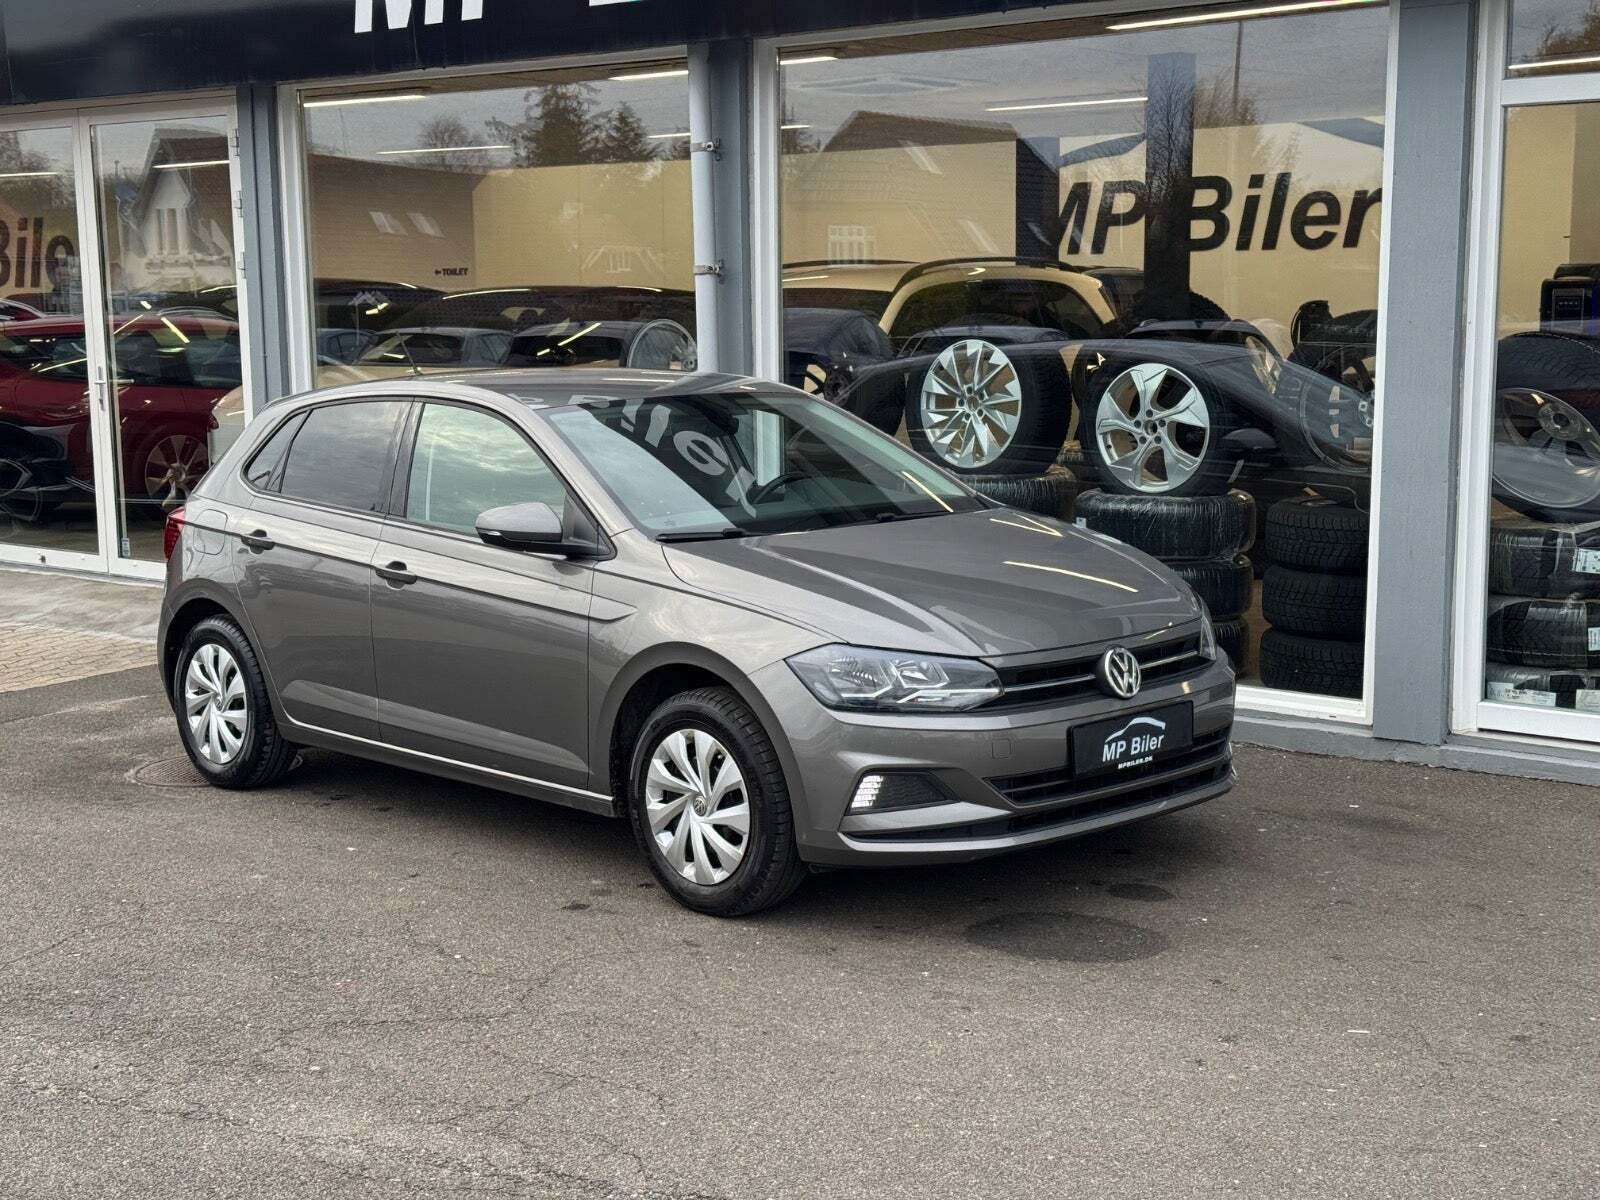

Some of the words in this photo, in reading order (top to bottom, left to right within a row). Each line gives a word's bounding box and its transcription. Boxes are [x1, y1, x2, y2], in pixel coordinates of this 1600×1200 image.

[1189, 172, 1382, 251] Biler
[442, 267, 468, 276] TOILET
[1103, 741, 1126, 762] MP
[1131, 734, 1164, 755] Biler
[1118, 756, 1153, 769] MPBILER.DK
